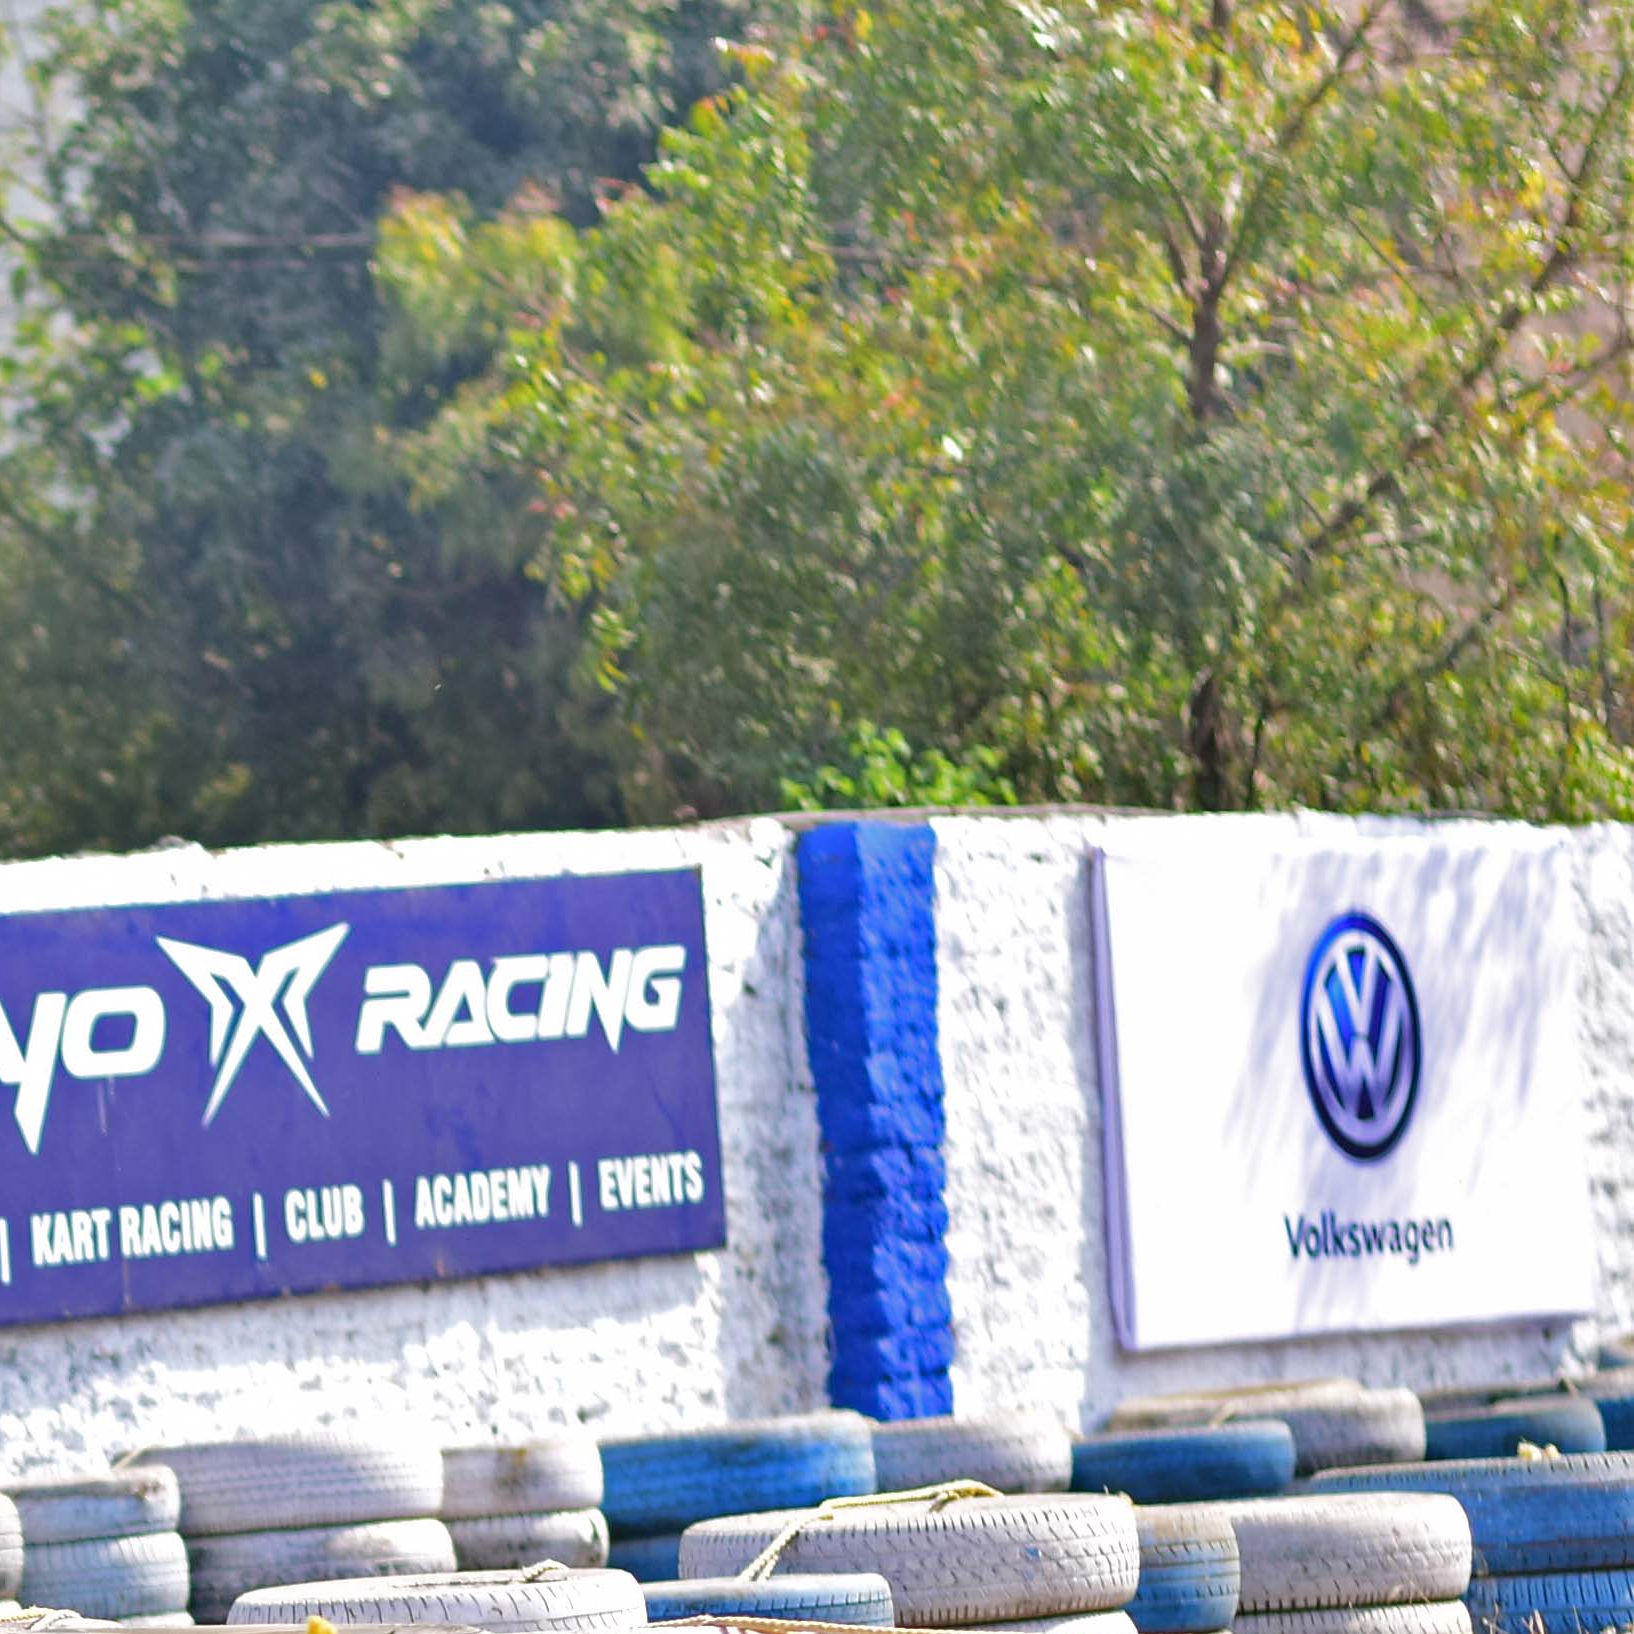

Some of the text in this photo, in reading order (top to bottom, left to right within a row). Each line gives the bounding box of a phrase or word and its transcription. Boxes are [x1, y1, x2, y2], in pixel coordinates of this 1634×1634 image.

[356, 943, 686, 1053] RACING
[32, 1204, 112, 1266] KART
[121, 1194, 232, 1258] RACING
[285, 1178, 363, 1240] CLUB
[415, 1164, 551, 1228] ACADEMY
[598, 1150, 704, 1211] EVENTS
[1285, 1211, 1453, 1266] Volkswagen
